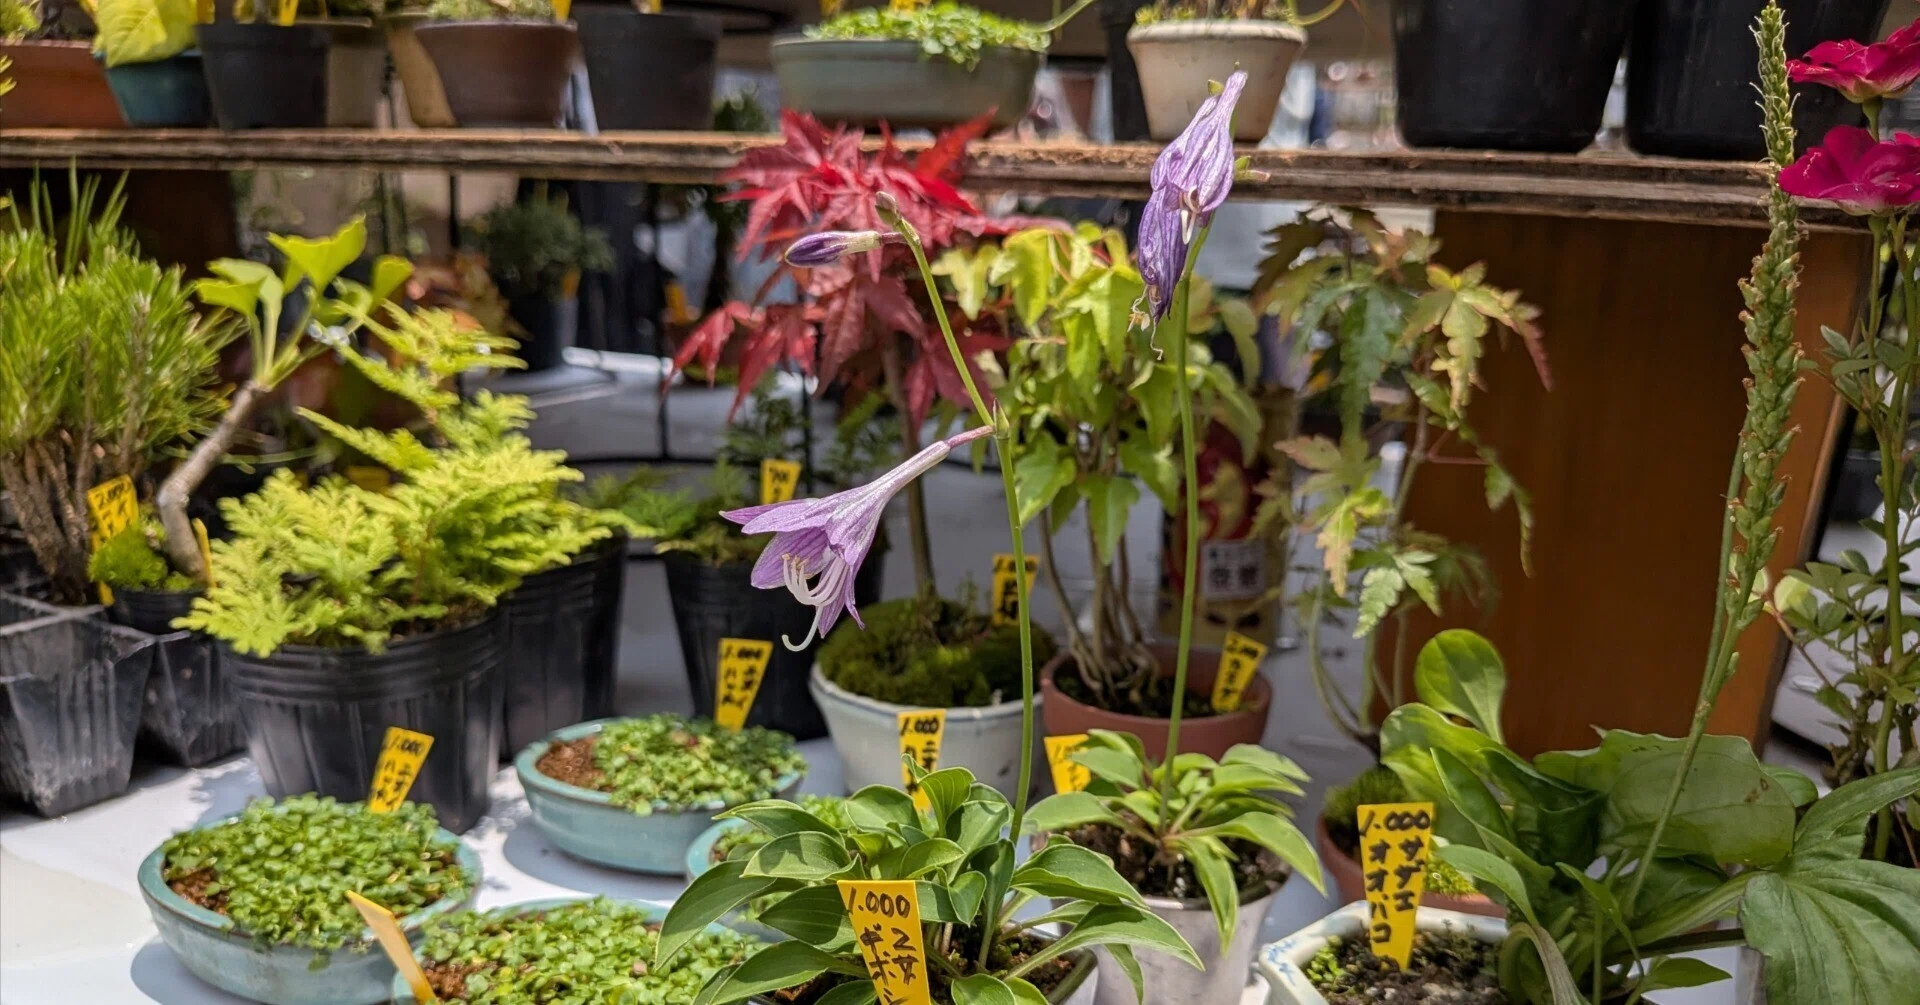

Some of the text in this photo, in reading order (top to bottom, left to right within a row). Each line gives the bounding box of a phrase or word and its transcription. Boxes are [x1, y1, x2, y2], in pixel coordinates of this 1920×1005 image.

[899, 716, 940, 737] 1.000
[388, 735, 426, 757] 1.000
[1360, 810, 1431, 837] 1.000
[1393, 835, 1426, 912] サザエ
[848, 886, 911, 919] 1.000
[1366, 839, 1393, 944] オオバコ
